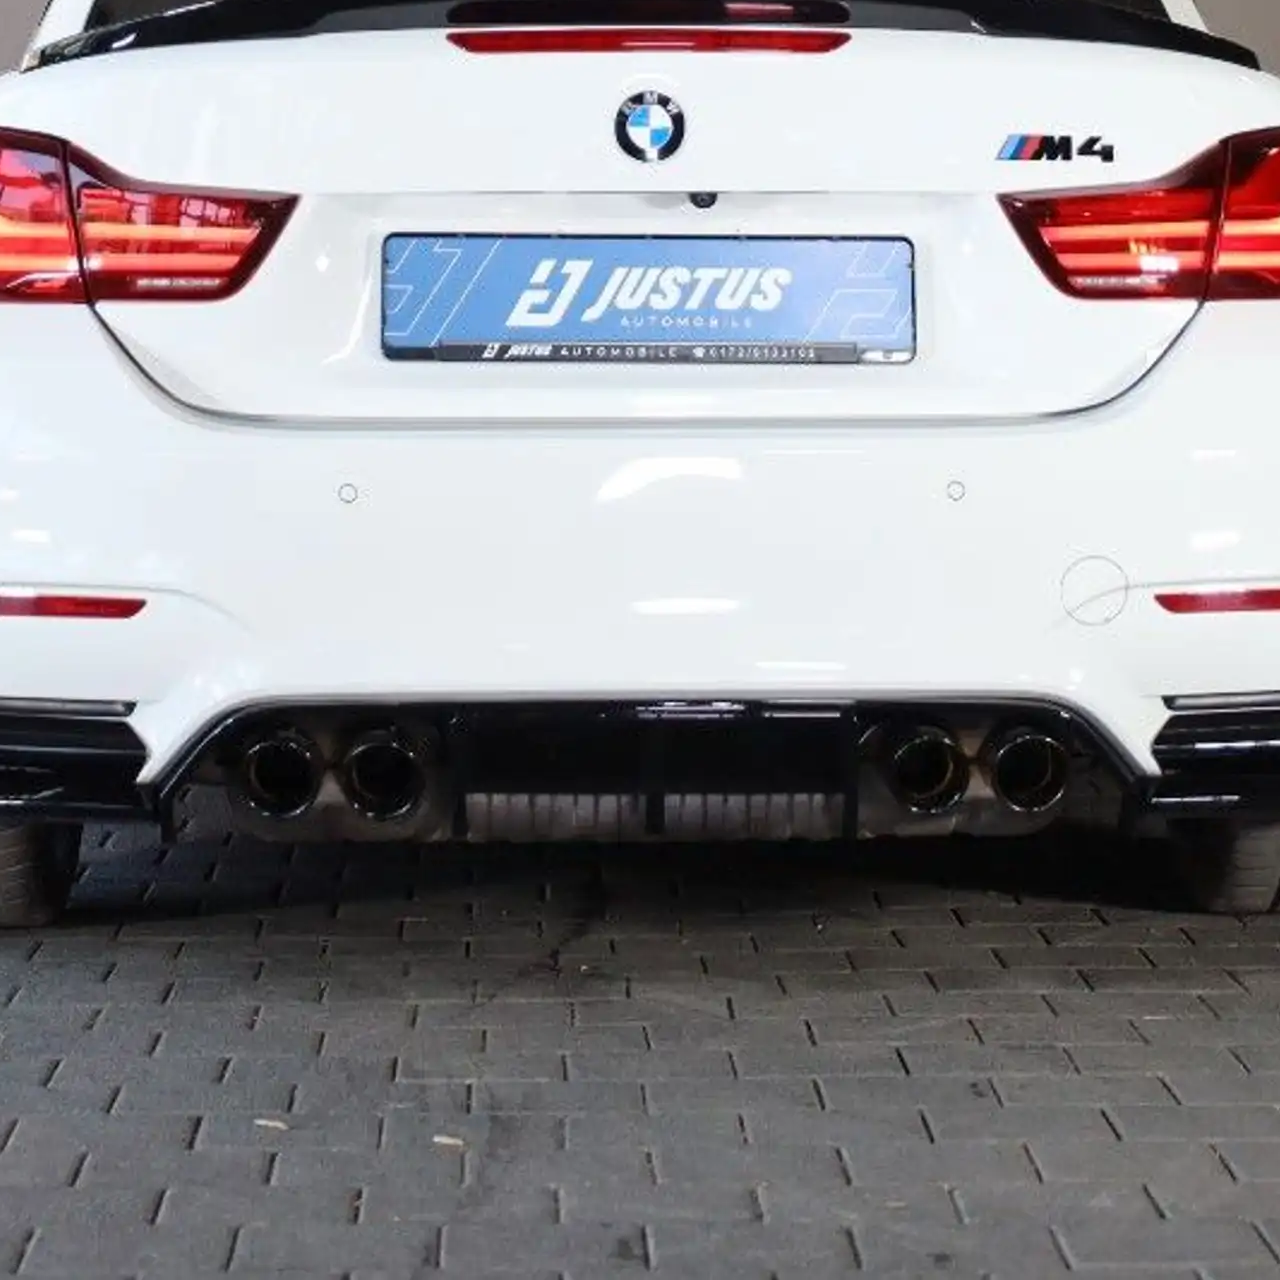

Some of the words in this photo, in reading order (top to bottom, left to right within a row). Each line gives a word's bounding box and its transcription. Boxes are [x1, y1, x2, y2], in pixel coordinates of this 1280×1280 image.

[1029, 135, 1115, 163] M4
[580, 266, 792, 322] JUSTUS
[620, 315, 752, 328] AUTOMOBILE
[560, 346, 678, 358] AUTOMOBILE
